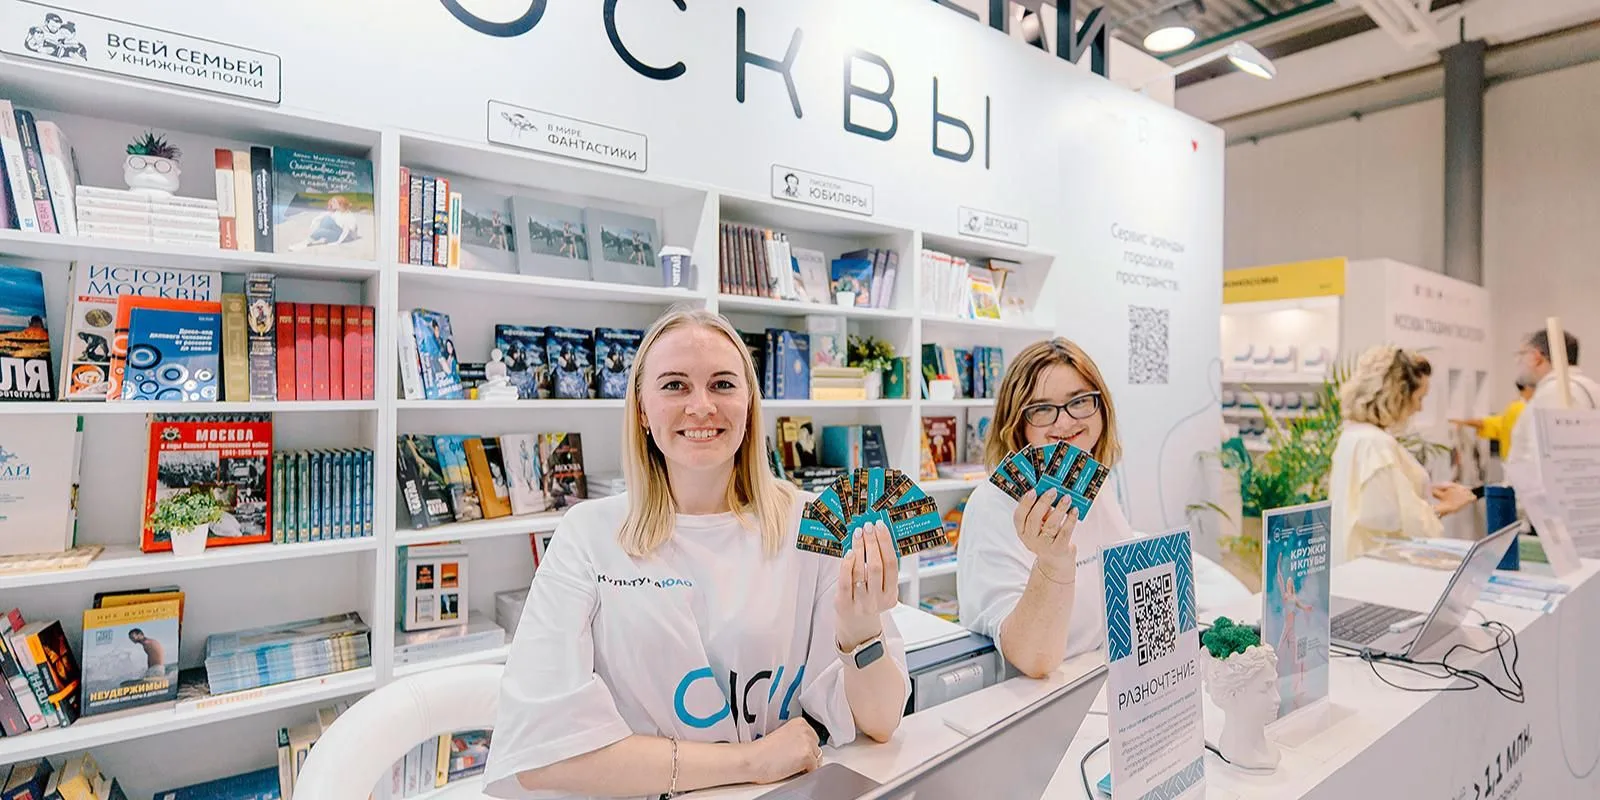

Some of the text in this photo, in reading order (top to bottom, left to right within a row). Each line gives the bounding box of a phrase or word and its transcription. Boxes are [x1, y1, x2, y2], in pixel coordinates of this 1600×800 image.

[107, 33, 264, 77] ВСЕЙ СЕМЬЕЙ
[107, 50, 264, 89] У КНИЖНОЙ ПОЛКИ
[556, 126, 582, 137] МИРЕ
[547, 134, 638, 161] ФАНТАСТИКИ
[809, 187, 868, 209] ЮБИЛЯРЫ
[984, 216, 1019, 232] ДЕТСКАЯ
[1111, 221, 1148, 246] Сервис
[89, 264, 211, 289] ИСТОРИЯ
[87, 280, 210, 302] МОСКВЫ
[195, 428, 254, 442] МОСКВА
[1290, 543, 1327, 560] КРУЖКИ
[1290, 561, 1297, 571] И
[1297, 554, 1326, 569] КЛУБЫ
[89, 679, 170, 702] НЕУДЕРЖИМЫЙ
[1118, 659, 1196, 711] РАЗНОЧТЕНИЕ
[1506, 723, 1533, 773] МЛН.
